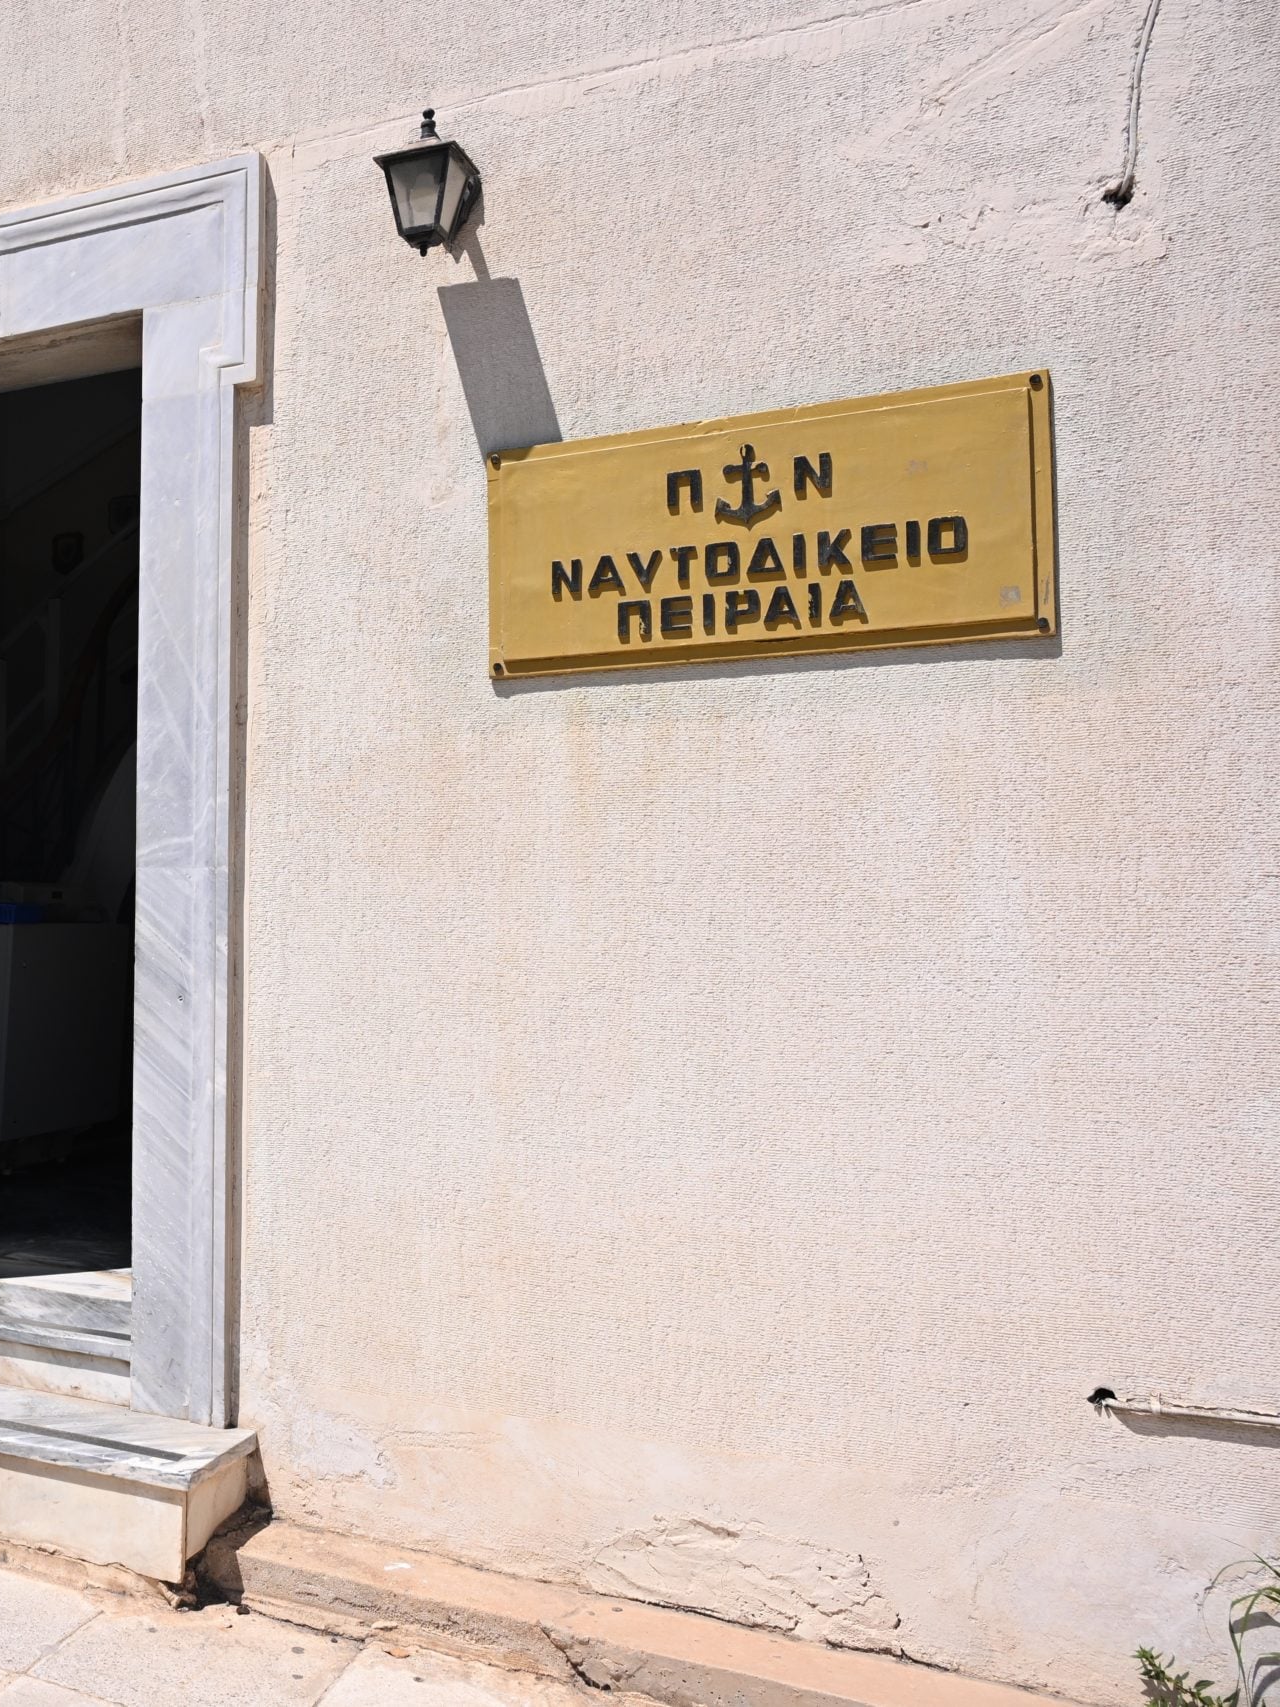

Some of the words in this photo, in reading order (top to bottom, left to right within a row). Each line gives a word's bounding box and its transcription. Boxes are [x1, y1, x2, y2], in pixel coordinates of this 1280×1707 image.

[666, 469, 703, 511] Π
[793, 452, 831, 493] Ν
[551, 515, 968, 598] ΝΑΥΤΟΔΙΚΕΙΟ
[617, 579, 869, 640] ΠΕΙΡΑΙΑ
